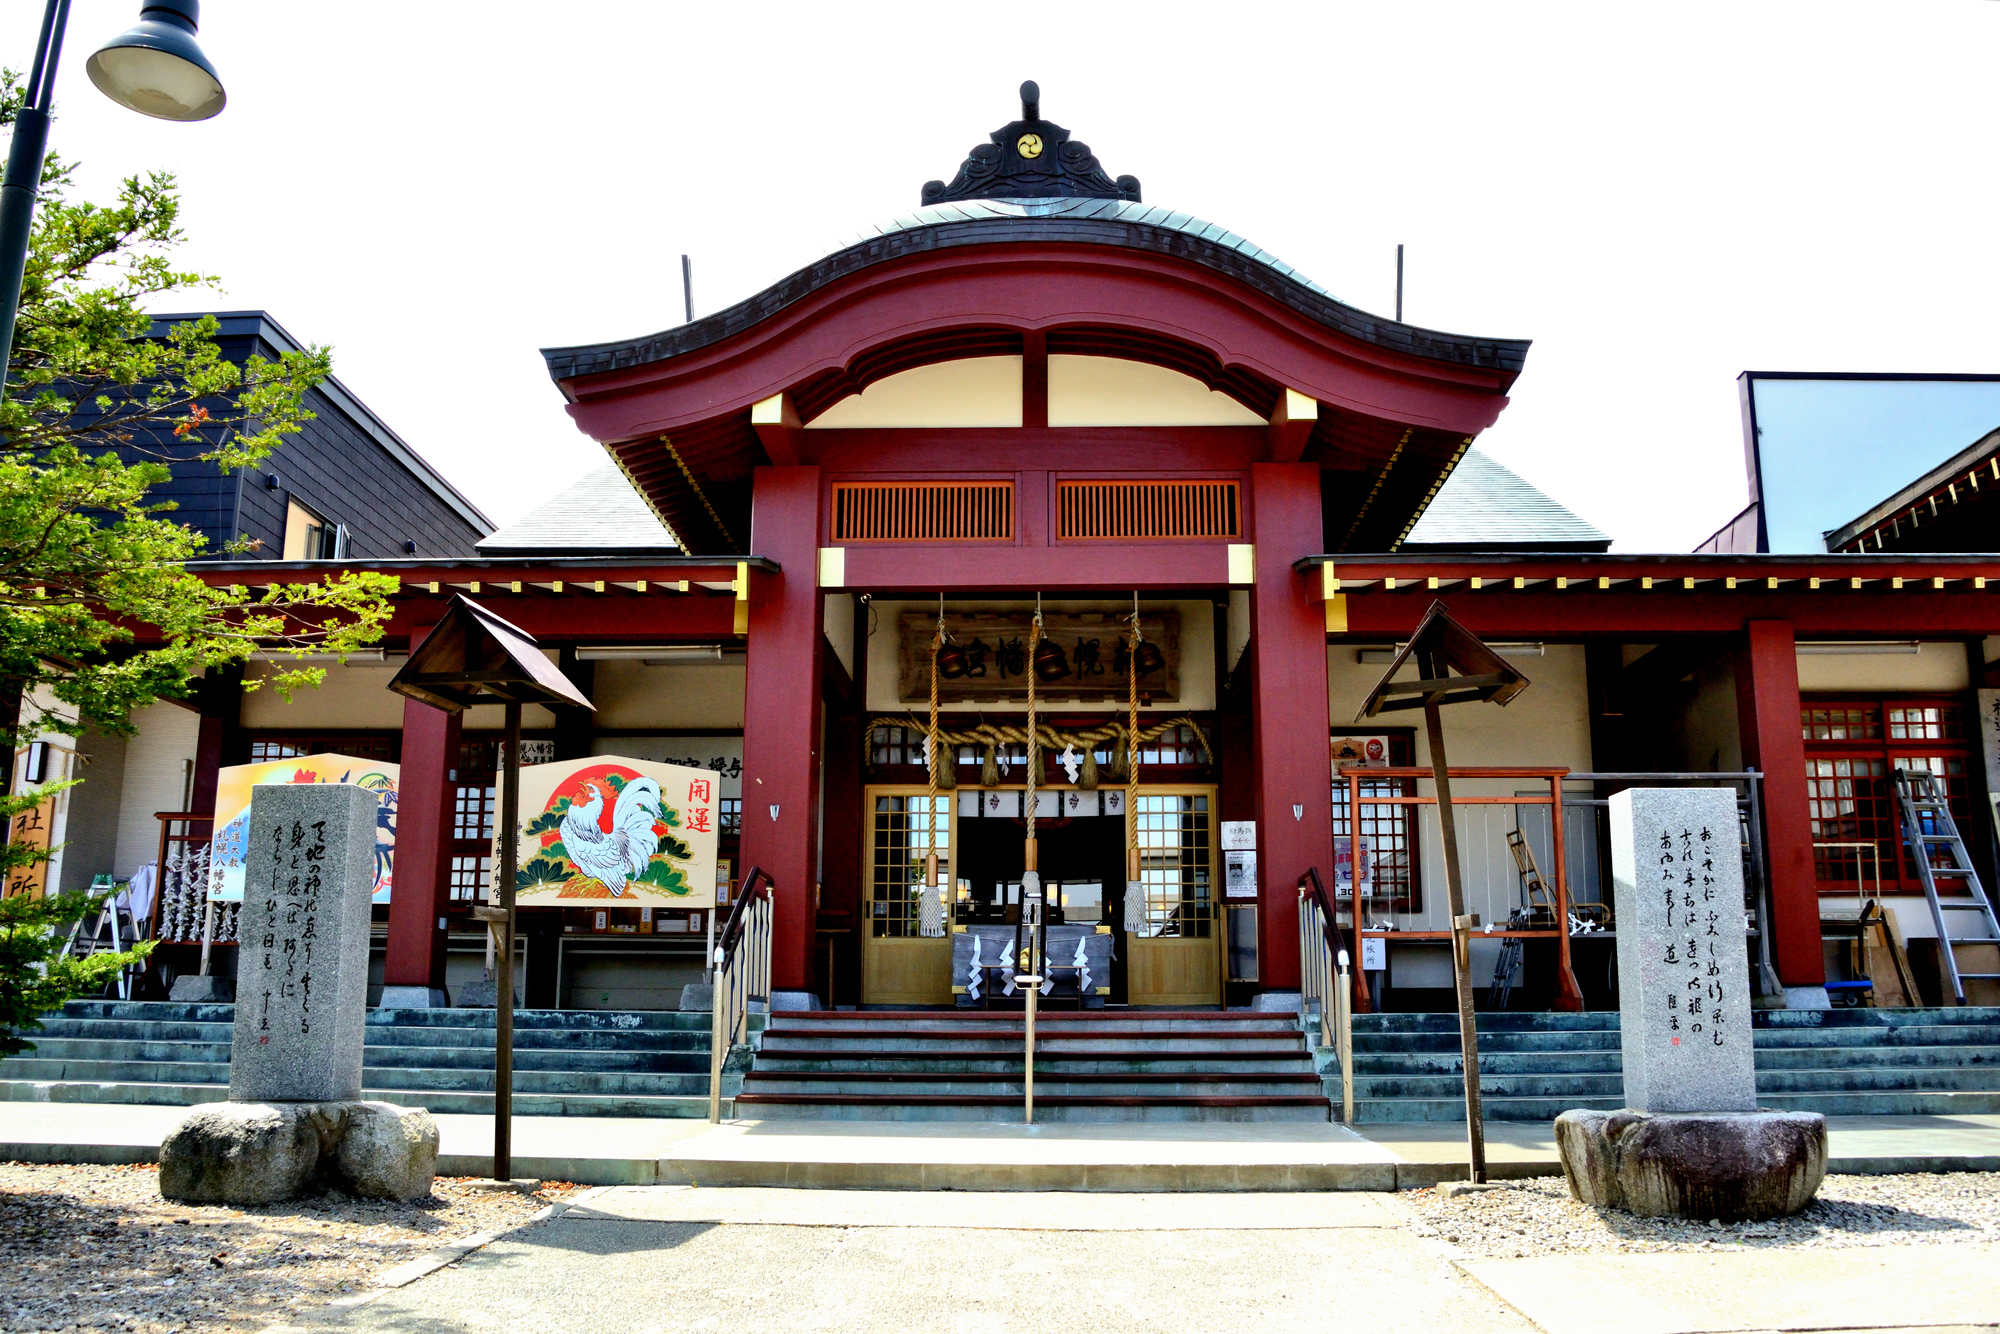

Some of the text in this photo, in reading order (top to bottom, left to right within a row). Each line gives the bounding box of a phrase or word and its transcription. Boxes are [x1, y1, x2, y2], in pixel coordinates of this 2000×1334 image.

[686, 778, 713, 833] 開運
[212, 829, 229, 895] 札幌八幡宮
[228, 818, 243, 868] 神道大教
